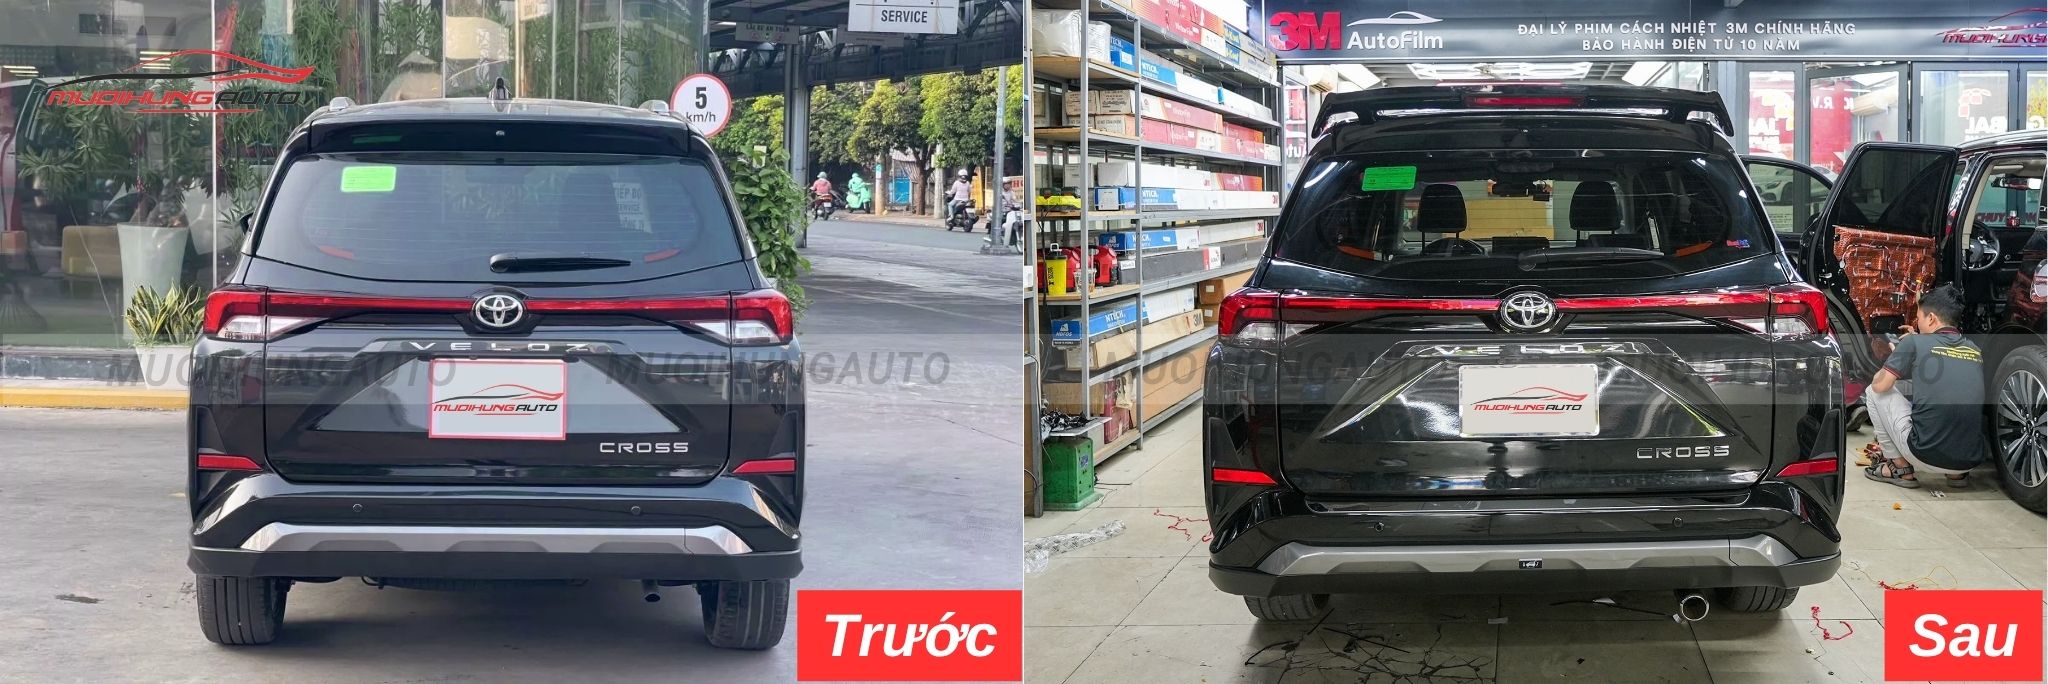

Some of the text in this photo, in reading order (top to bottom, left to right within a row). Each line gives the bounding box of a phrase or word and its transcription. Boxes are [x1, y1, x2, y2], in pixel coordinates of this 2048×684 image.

[881, 9, 928, 24] SERVICE
[1268, 11, 1342, 50] 3M
[1347, 31, 1443, 49] AutoFilm
[1517, 24, 1543, 37] ĐẠI
[1574, 23, 1613, 35] PHIM
[1619, 20, 1664, 34] CÁCH
[1671, 20, 1717, 36] NHIỆT
[1726, 22, 1748, 34] 3M
[1754, 21, 1803, 35] CHÍNH
[1810, 21, 1856, 35] HÃNG
[1582, 37, 1614, 51] BẢO
[1621, 36, 1665, 50] HÀNH
[1672, 37, 1707, 52] ĐIỆN
[1740, 39, 1757, 50] 10
[695, 86, 707, 109] 5
[686, 112, 716, 122] km/h
[409, 342, 589, 352] VELOZ
[599, 442, 689, 454] CROSS
[1636, 445, 1731, 460] CROSS
